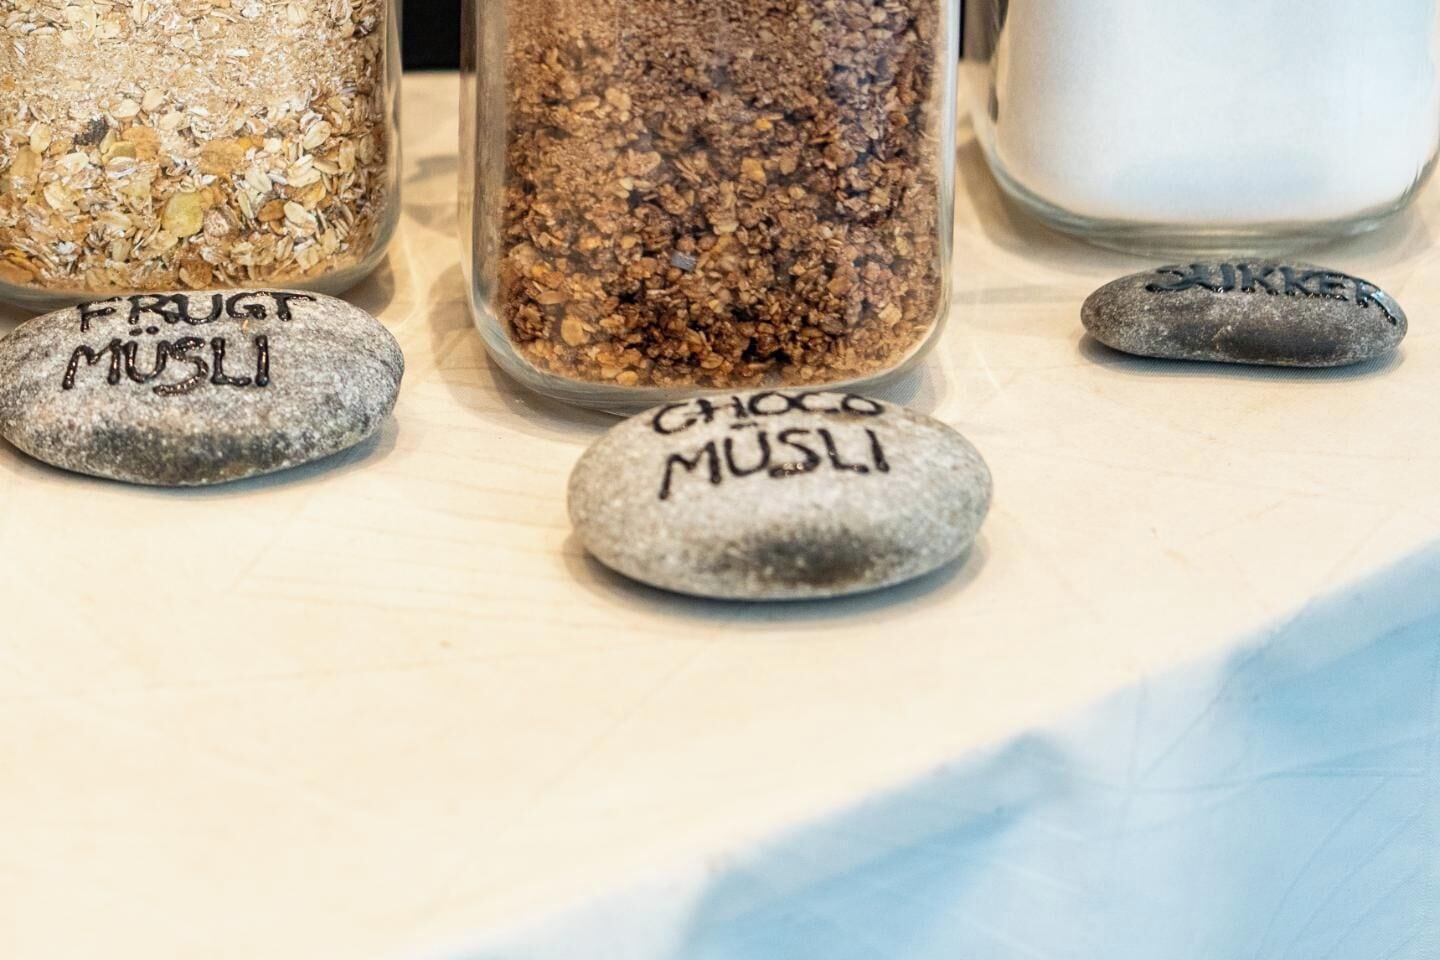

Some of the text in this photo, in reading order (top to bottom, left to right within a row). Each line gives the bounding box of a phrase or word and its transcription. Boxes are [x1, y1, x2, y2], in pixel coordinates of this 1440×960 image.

[77, 291, 316, 332] FRUGT
[62, 326, 270, 395] MÜSLI
[652, 391, 885, 435] CHOCO
